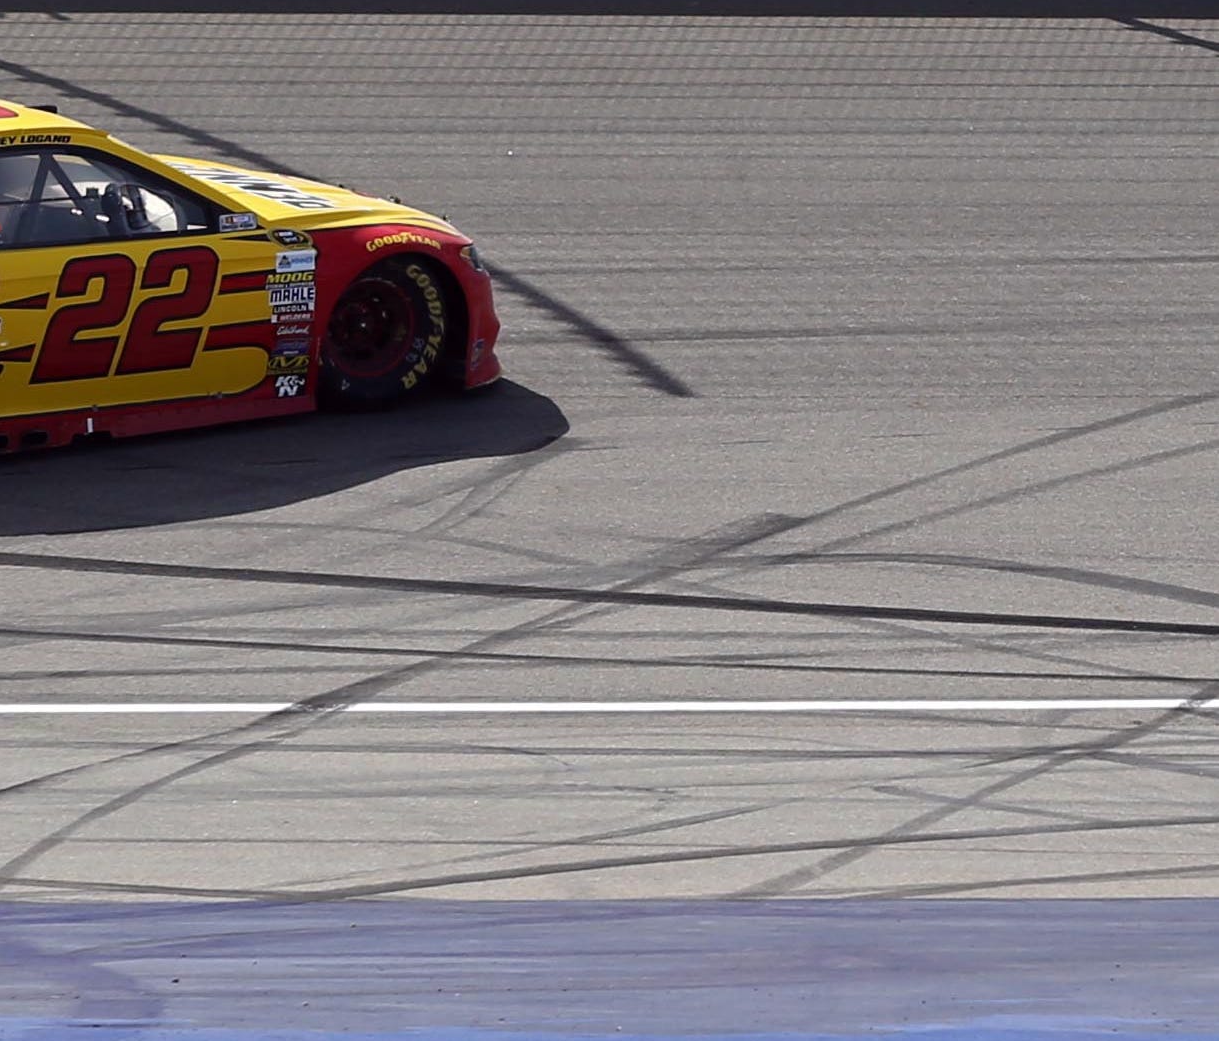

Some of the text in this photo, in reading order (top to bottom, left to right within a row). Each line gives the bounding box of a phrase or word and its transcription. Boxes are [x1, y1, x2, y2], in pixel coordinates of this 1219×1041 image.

[20, 135, 71, 144] LOGANO
[366, 231, 442, 253] GOODYEAR
[266, 272, 315, 284] MOOG
[270, 288, 315, 303] MAHLE
[29, 246, 220, 384] 22
[273, 304, 307, 313] LINCOLN
